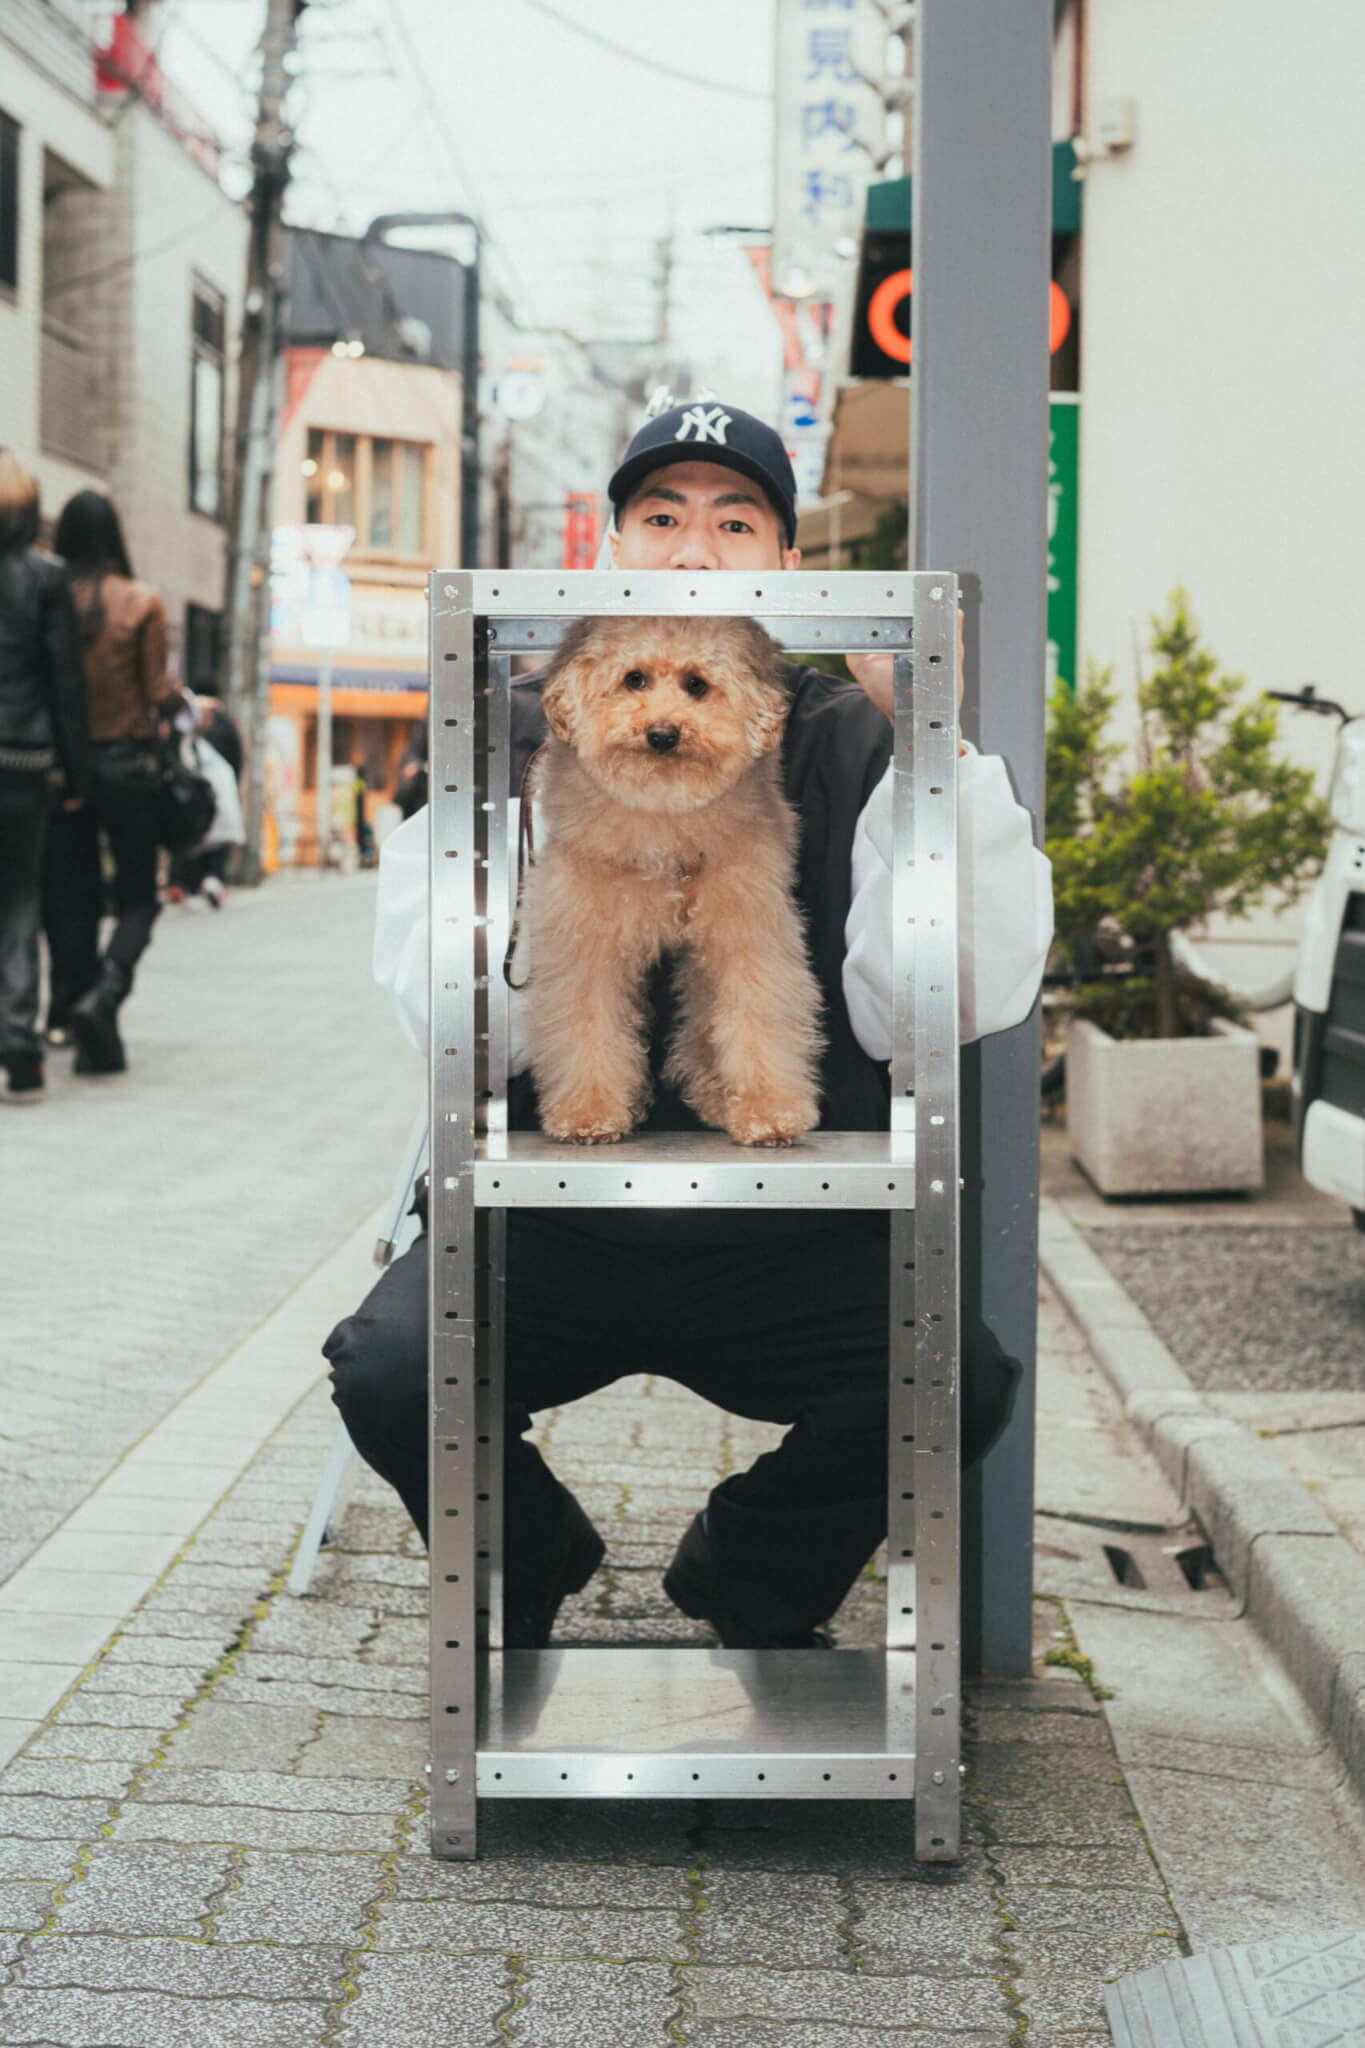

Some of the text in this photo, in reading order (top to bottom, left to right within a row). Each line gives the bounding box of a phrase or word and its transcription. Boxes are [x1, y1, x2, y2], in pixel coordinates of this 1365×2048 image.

[803, 0, 858, 223] 見内科
[675, 406, 732, 445] NY
